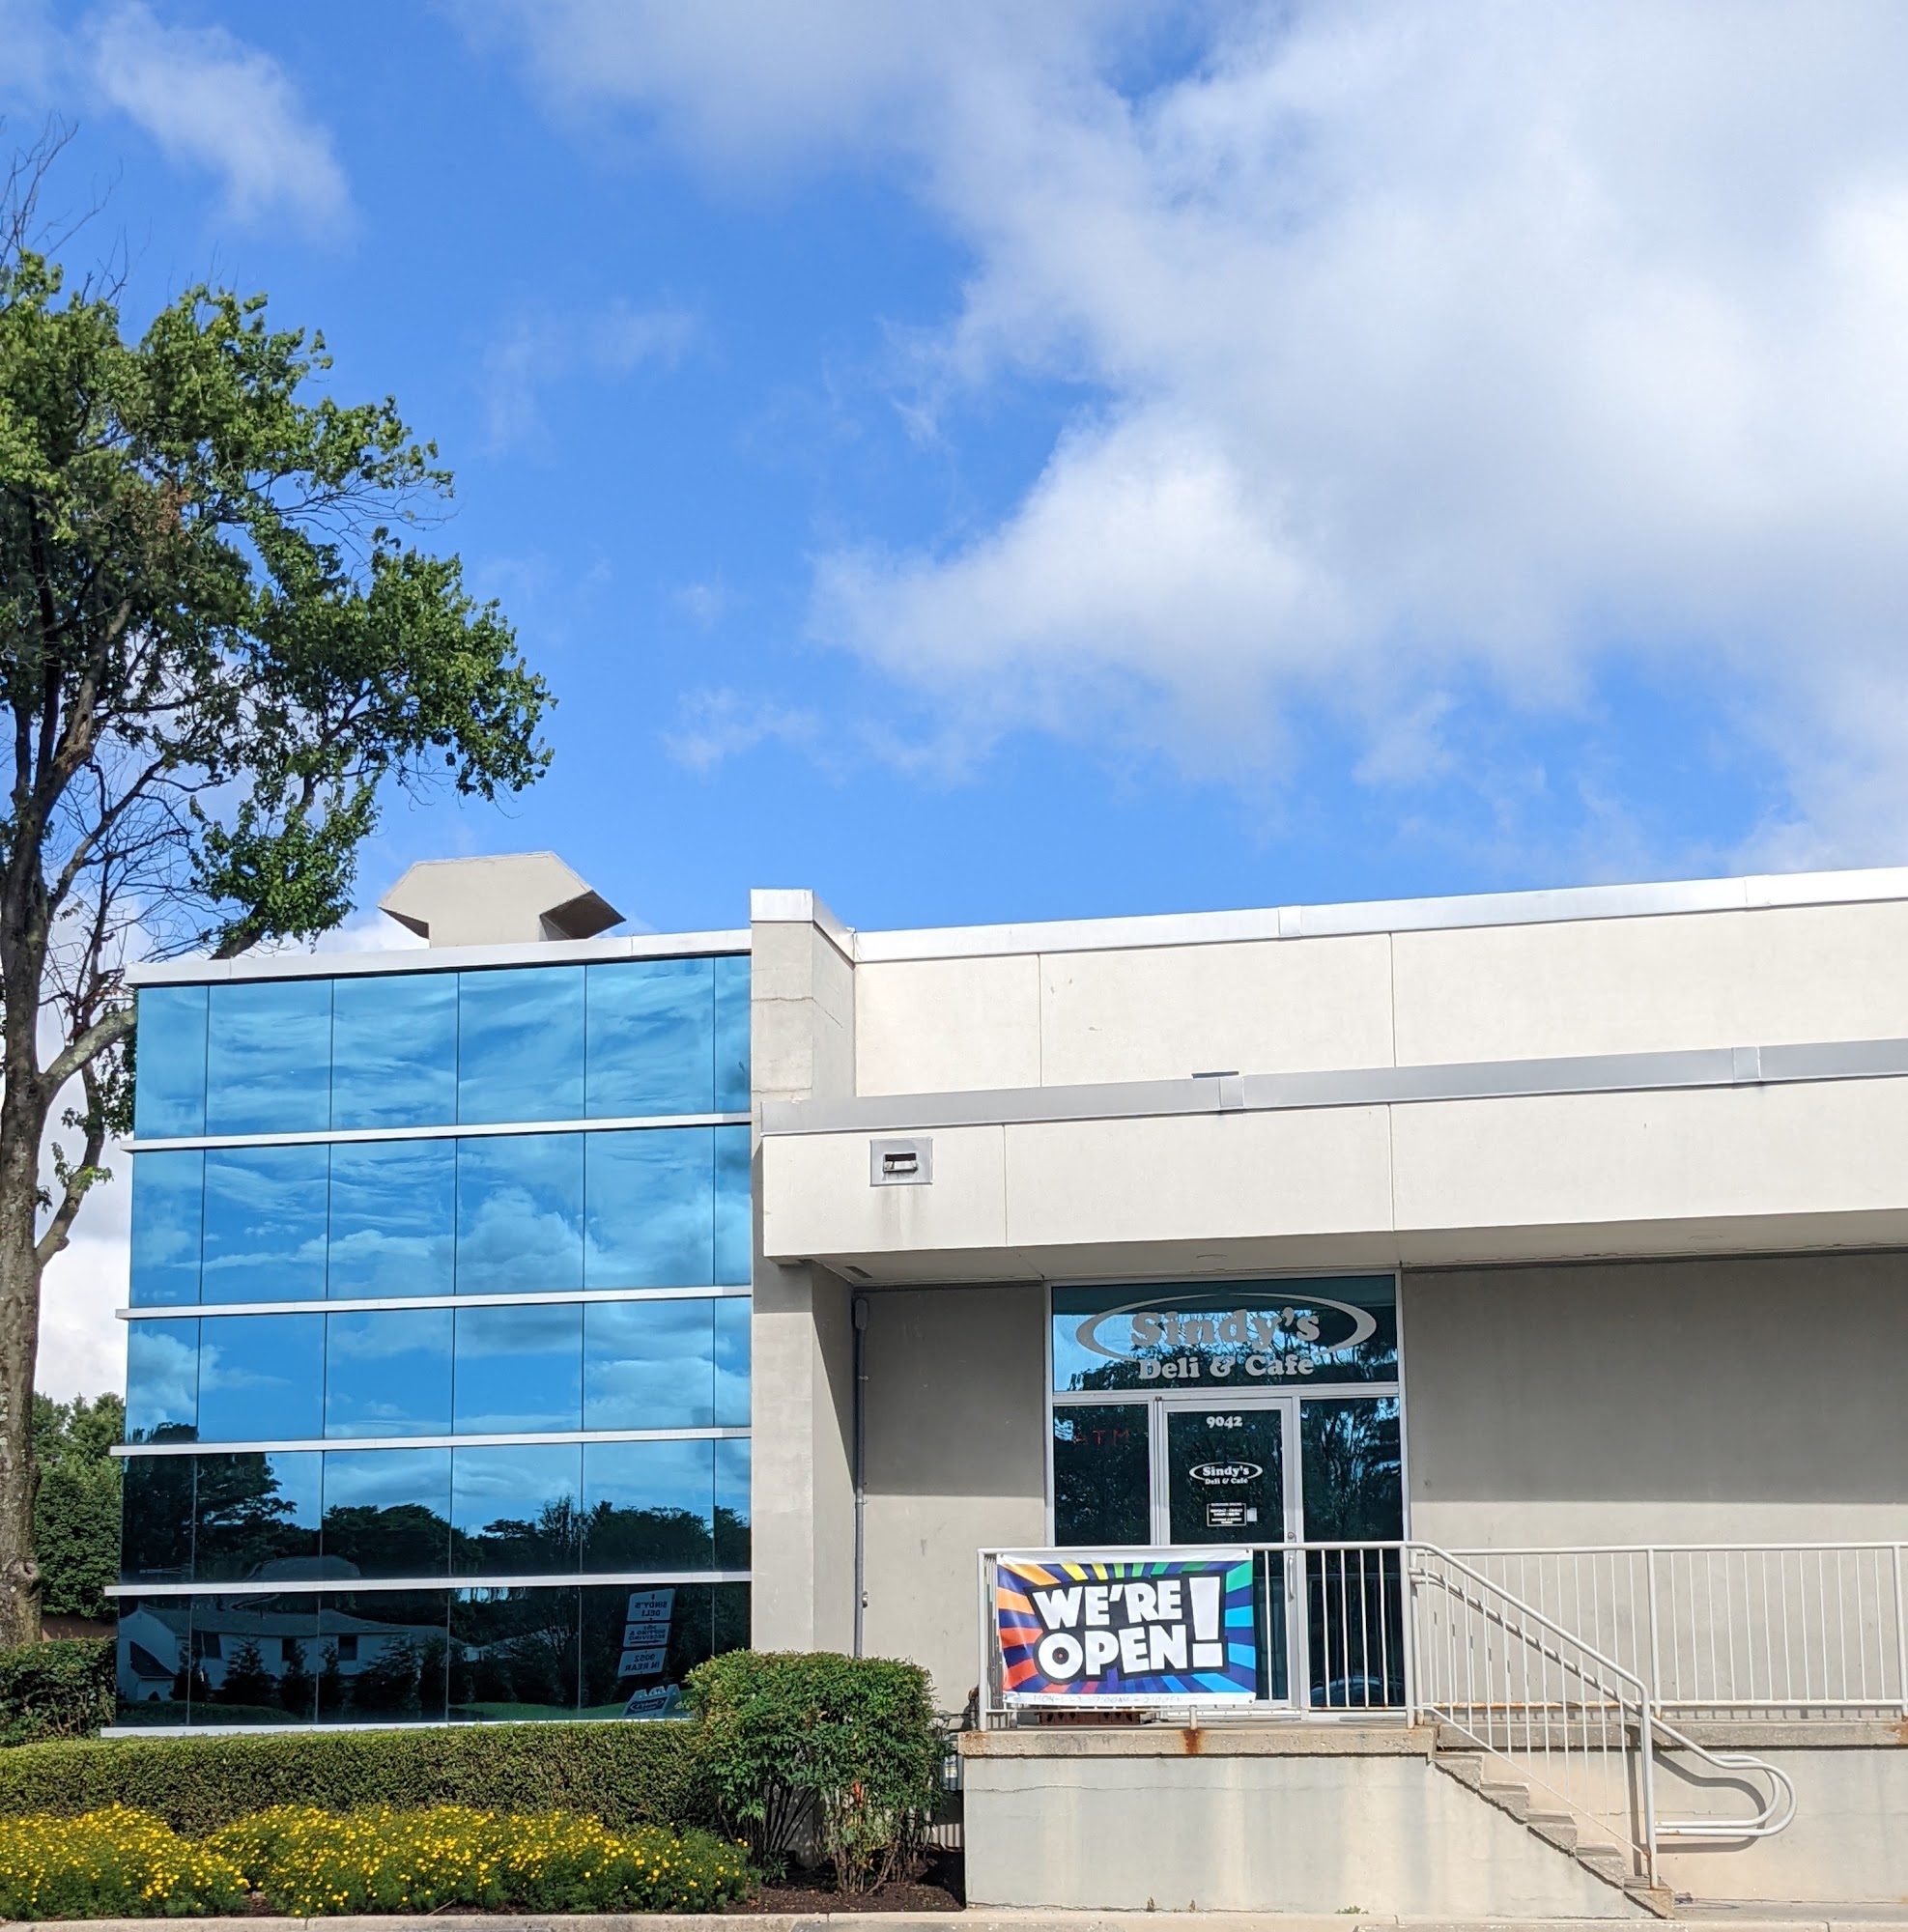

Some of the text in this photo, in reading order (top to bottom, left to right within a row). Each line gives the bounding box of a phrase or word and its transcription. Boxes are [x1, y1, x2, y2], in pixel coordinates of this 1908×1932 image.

[1131, 1306, 1320, 1350] Sindy's
[1138, 1355, 1200, 1379] Deli
[1210, 1355, 1236, 1378] &
[1206, 1415, 1243, 1429] 9042
[1202, 1464, 1250, 1477] Sindy's
[1032, 1579, 1182, 1630] WE'RE
